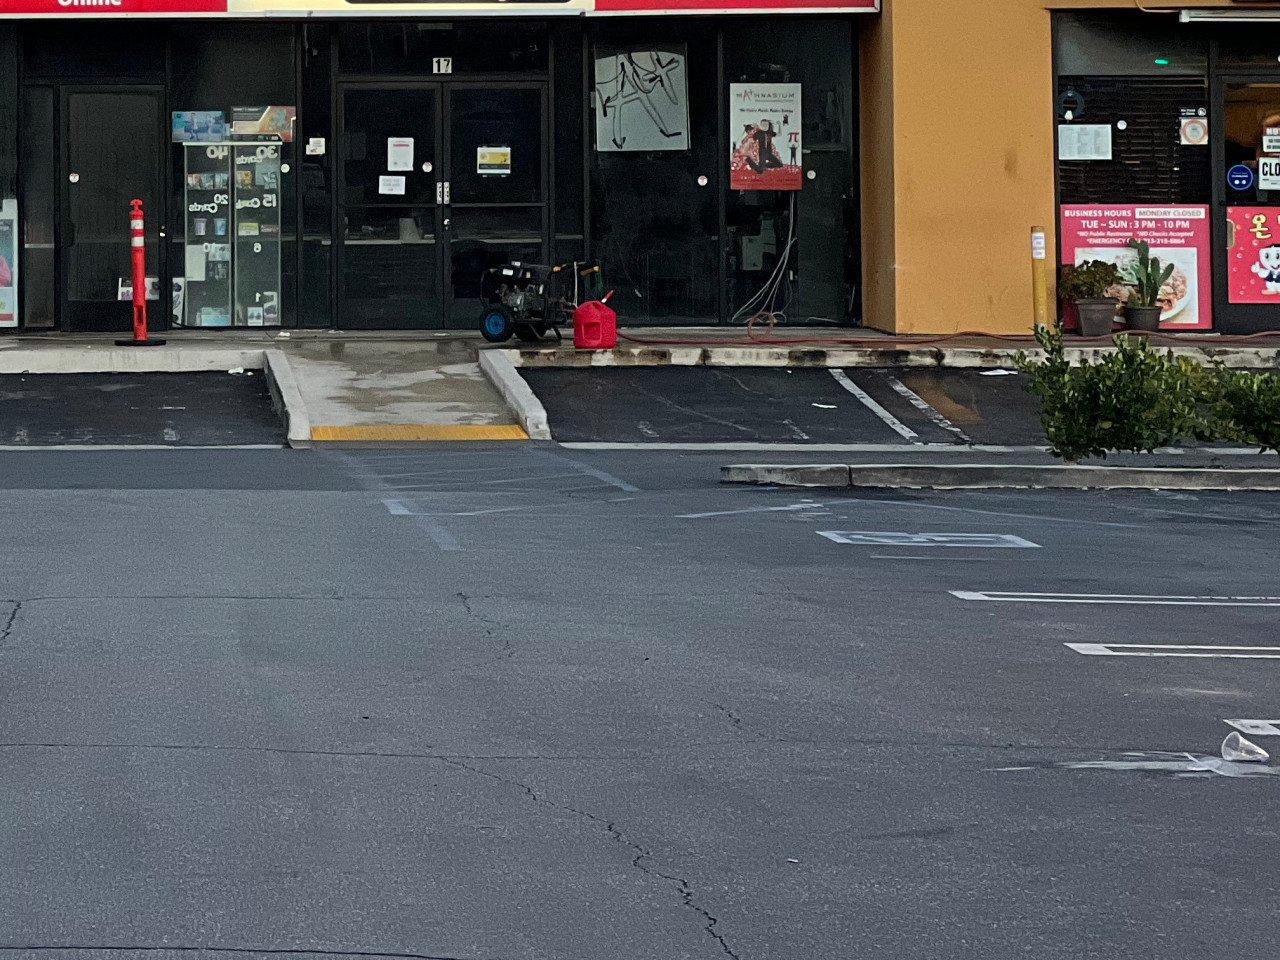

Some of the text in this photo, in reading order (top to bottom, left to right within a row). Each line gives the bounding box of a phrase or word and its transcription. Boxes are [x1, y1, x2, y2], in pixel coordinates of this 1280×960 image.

[435, 58, 451, 73] 17
[1081, 220, 1098, 228] TUE
[1108, 220, 1128, 228] SUN
[1134, 220, 1140, 228] 3
[1141, 220, 1156, 228] PM
[1163, 220, 1174, 228] 10
[1176, 220, 1190, 228] PM
